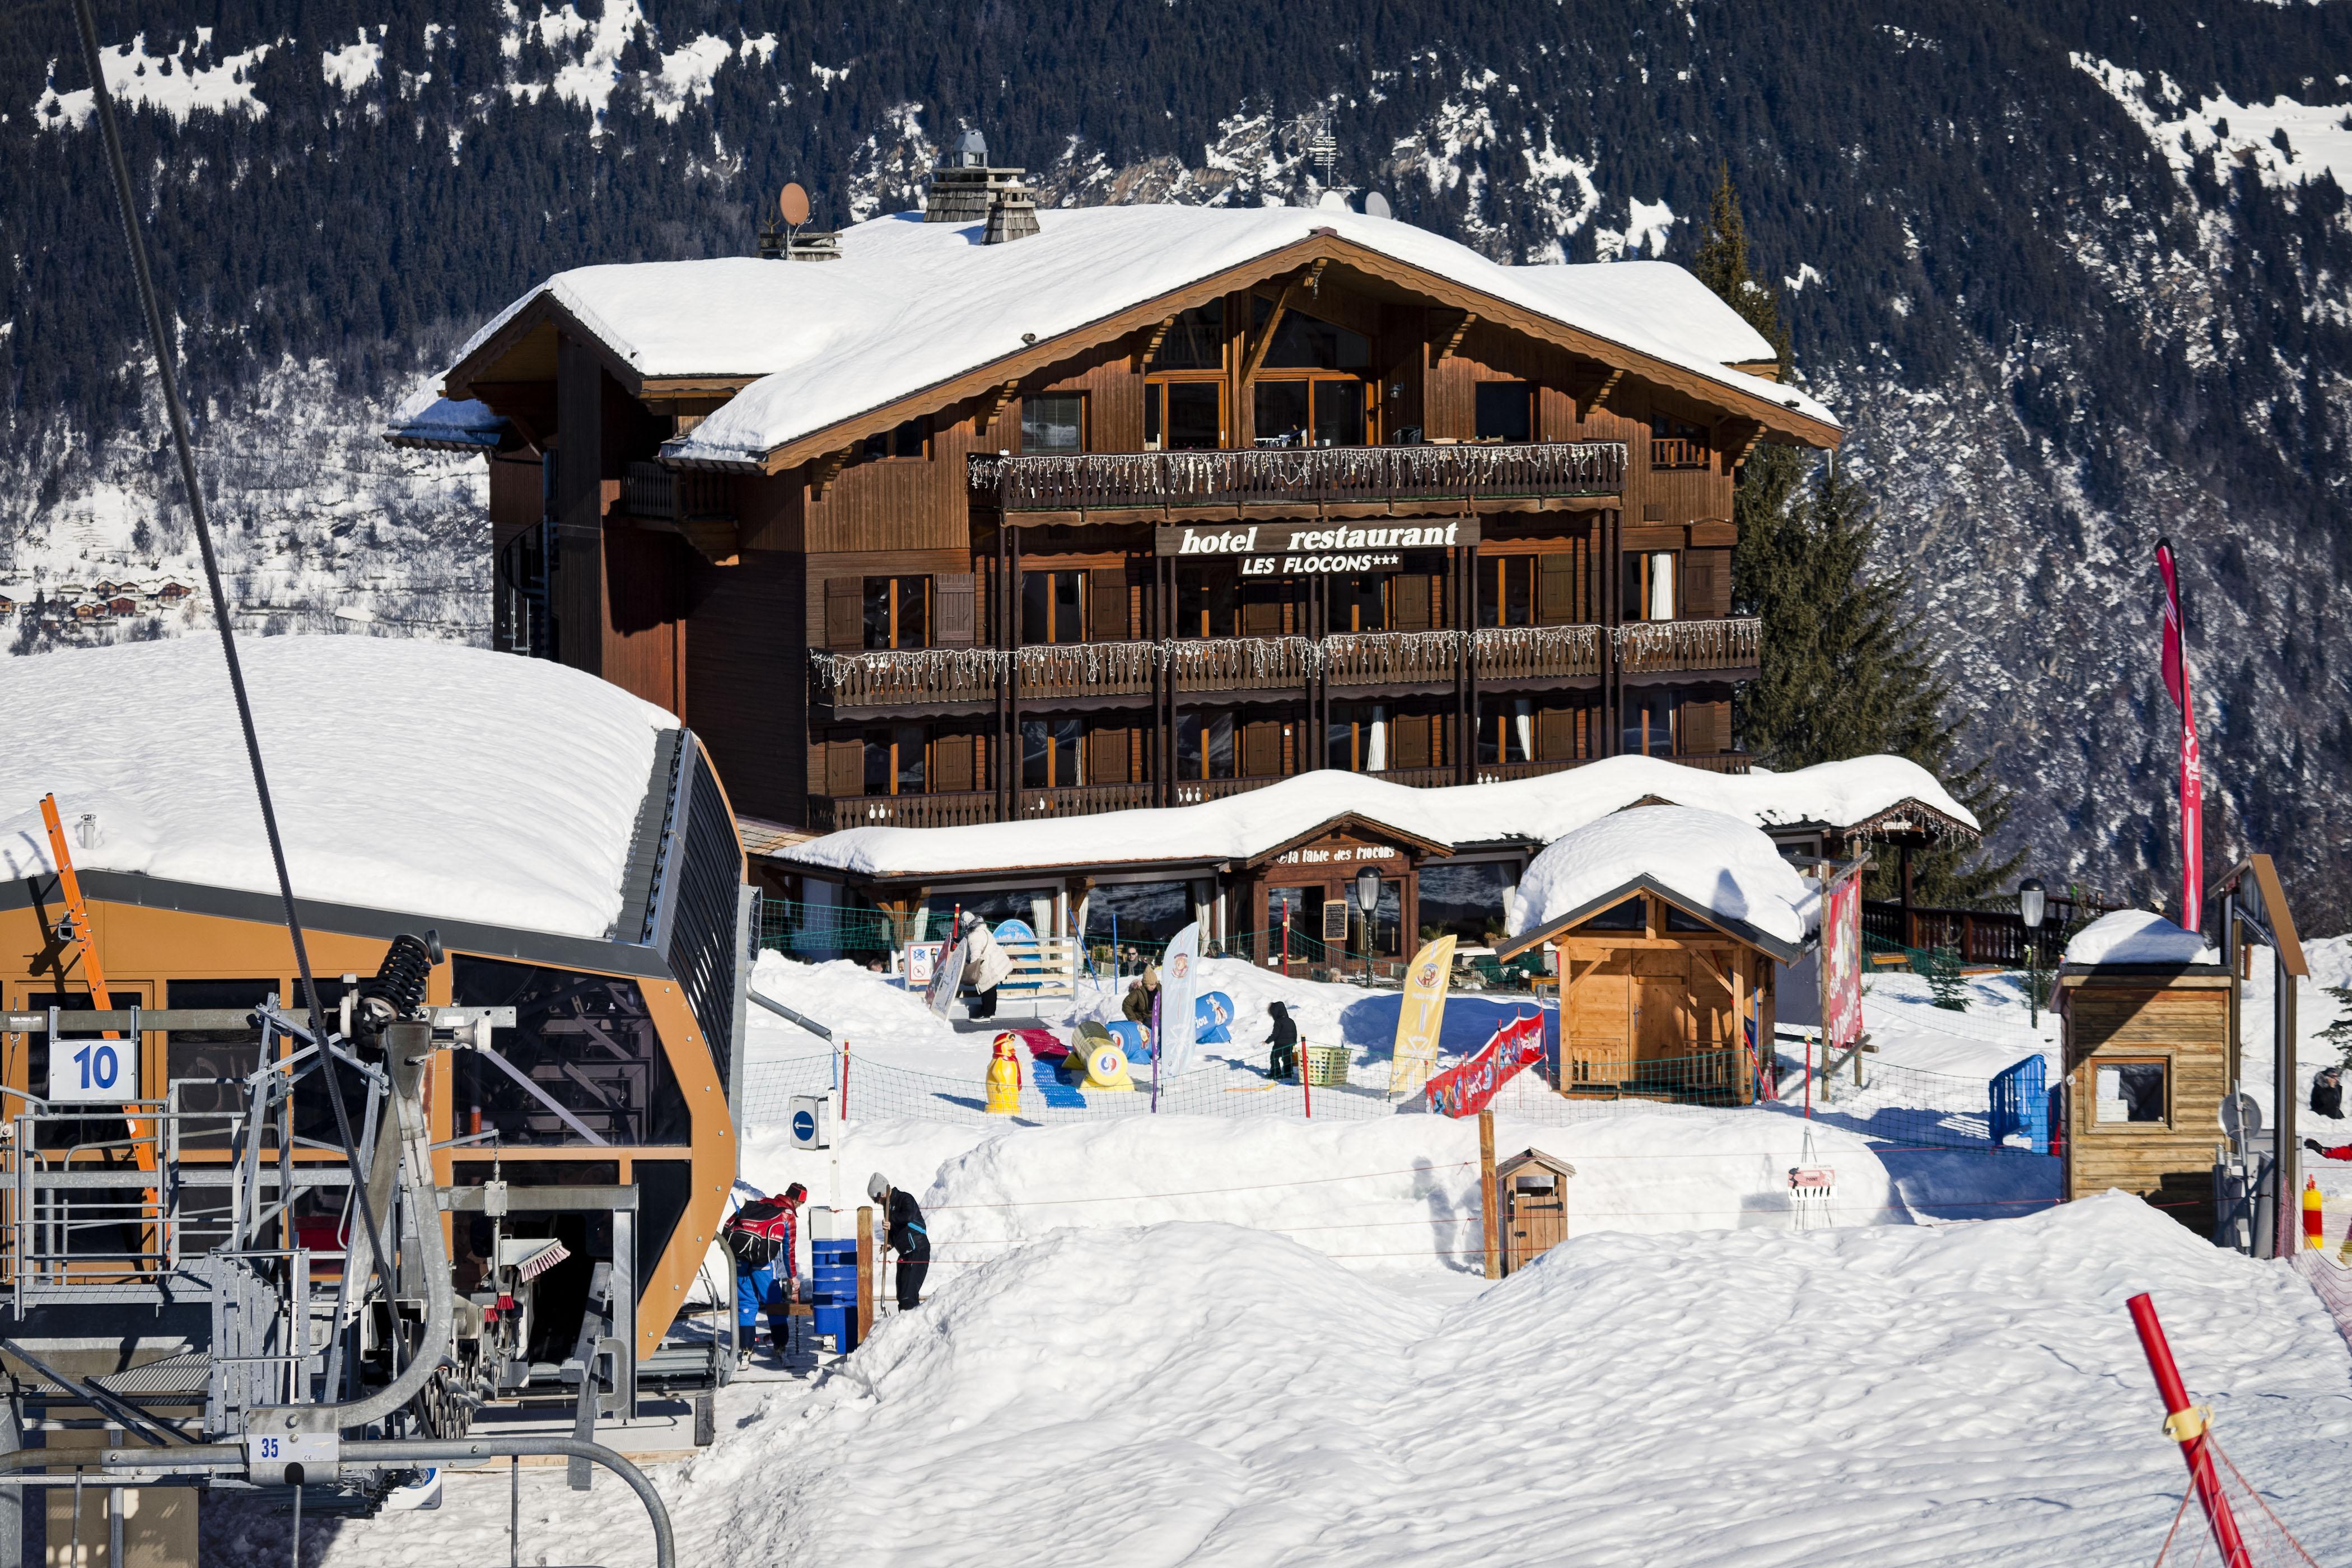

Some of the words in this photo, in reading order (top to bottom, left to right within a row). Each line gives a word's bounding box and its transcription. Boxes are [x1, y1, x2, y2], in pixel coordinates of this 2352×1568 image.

[1178, 526, 1258, 554] hotel
[1287, 522, 1459, 550] restaurant
[1242, 557, 1275, 575] LES
[1287, 851, 1299, 864] la
[1302, 848, 1330, 863] table
[1333, 849, 1351, 861] des
[73, 1044, 118, 1089] 10
[261, 1438, 278, 1458] 35
